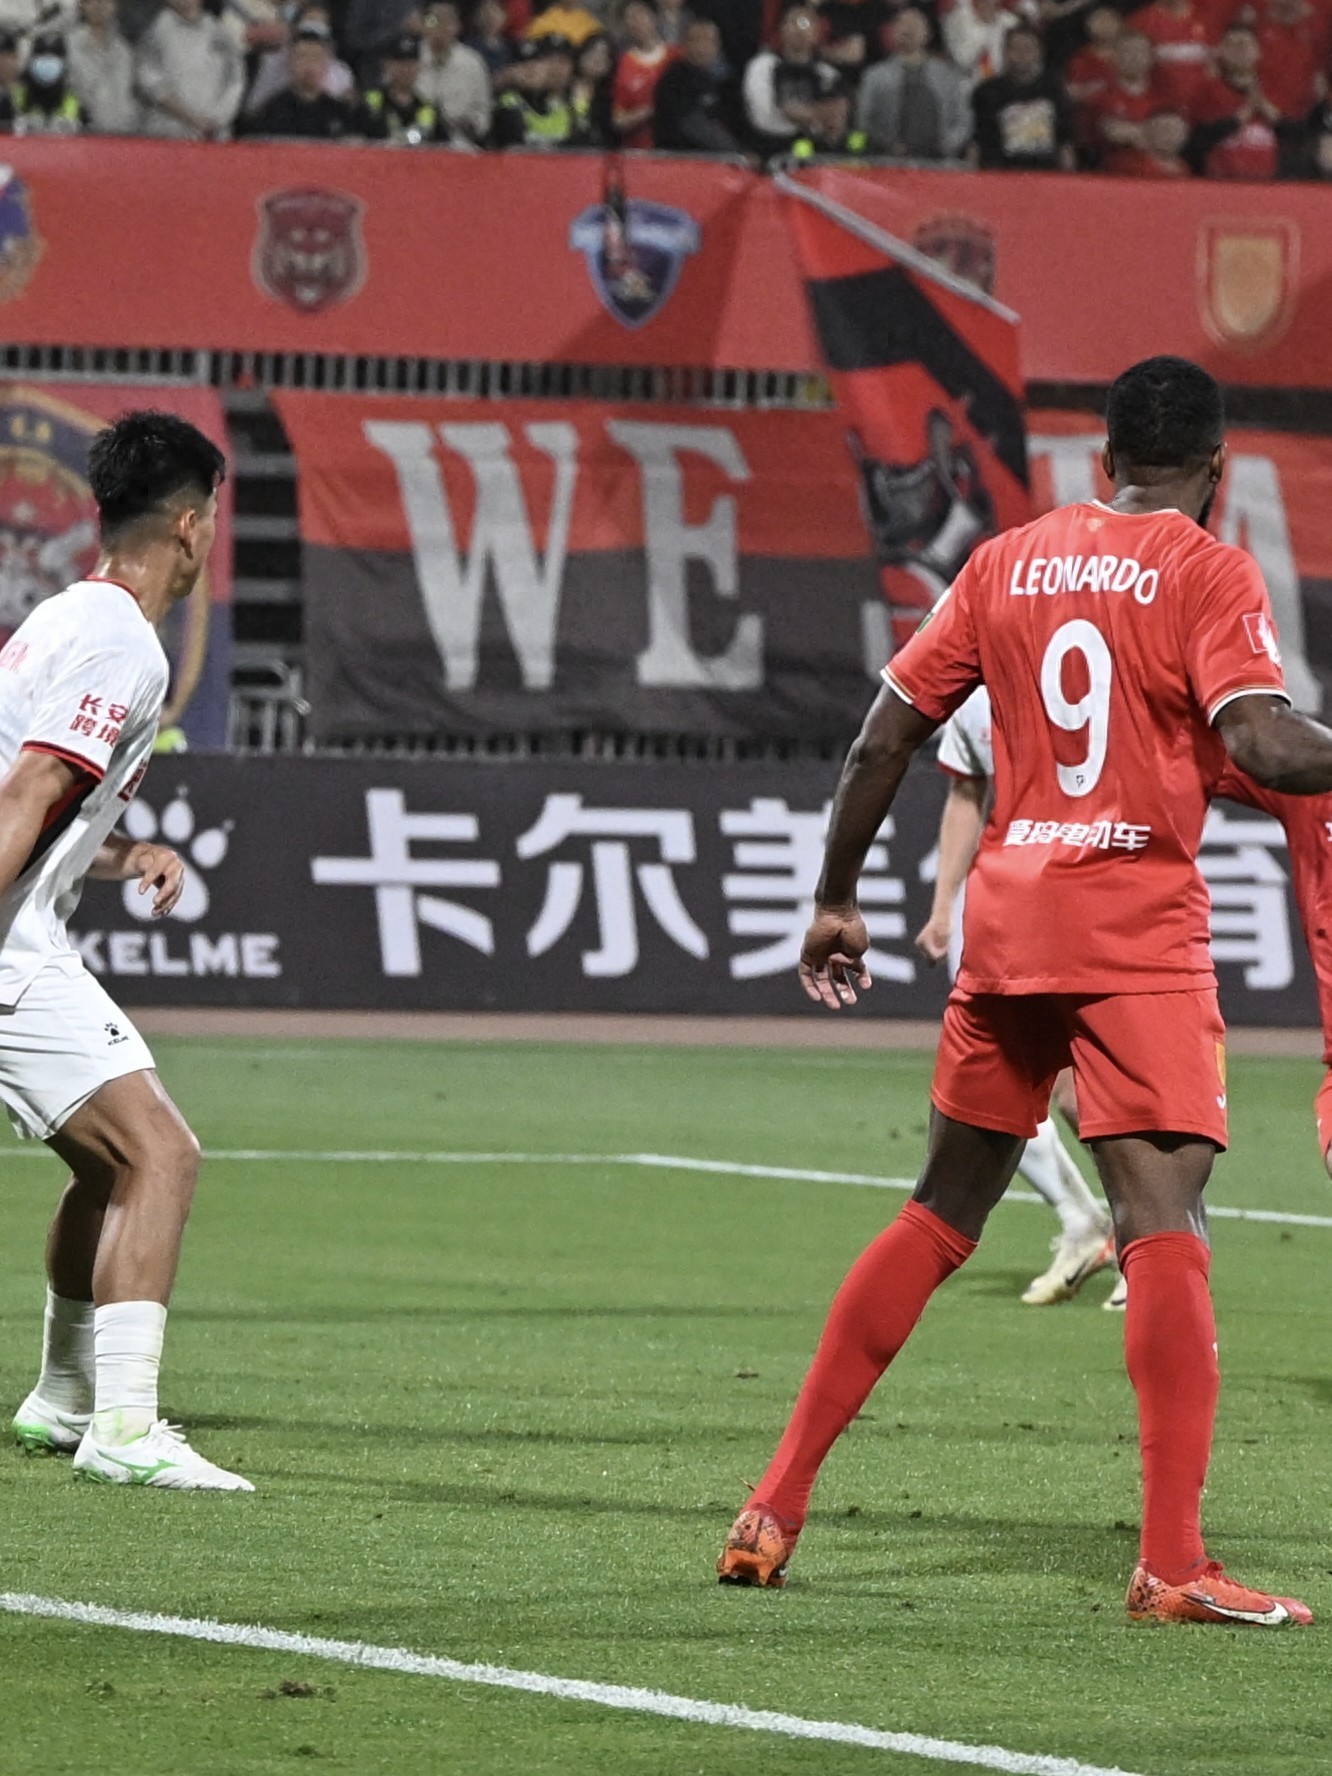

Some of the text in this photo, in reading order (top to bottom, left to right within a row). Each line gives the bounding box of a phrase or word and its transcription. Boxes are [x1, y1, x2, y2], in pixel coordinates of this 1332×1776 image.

[362, 420, 764, 690] WE
[1010, 555, 1160, 604] LEONARDO
[1040, 619, 1112, 797] 9
